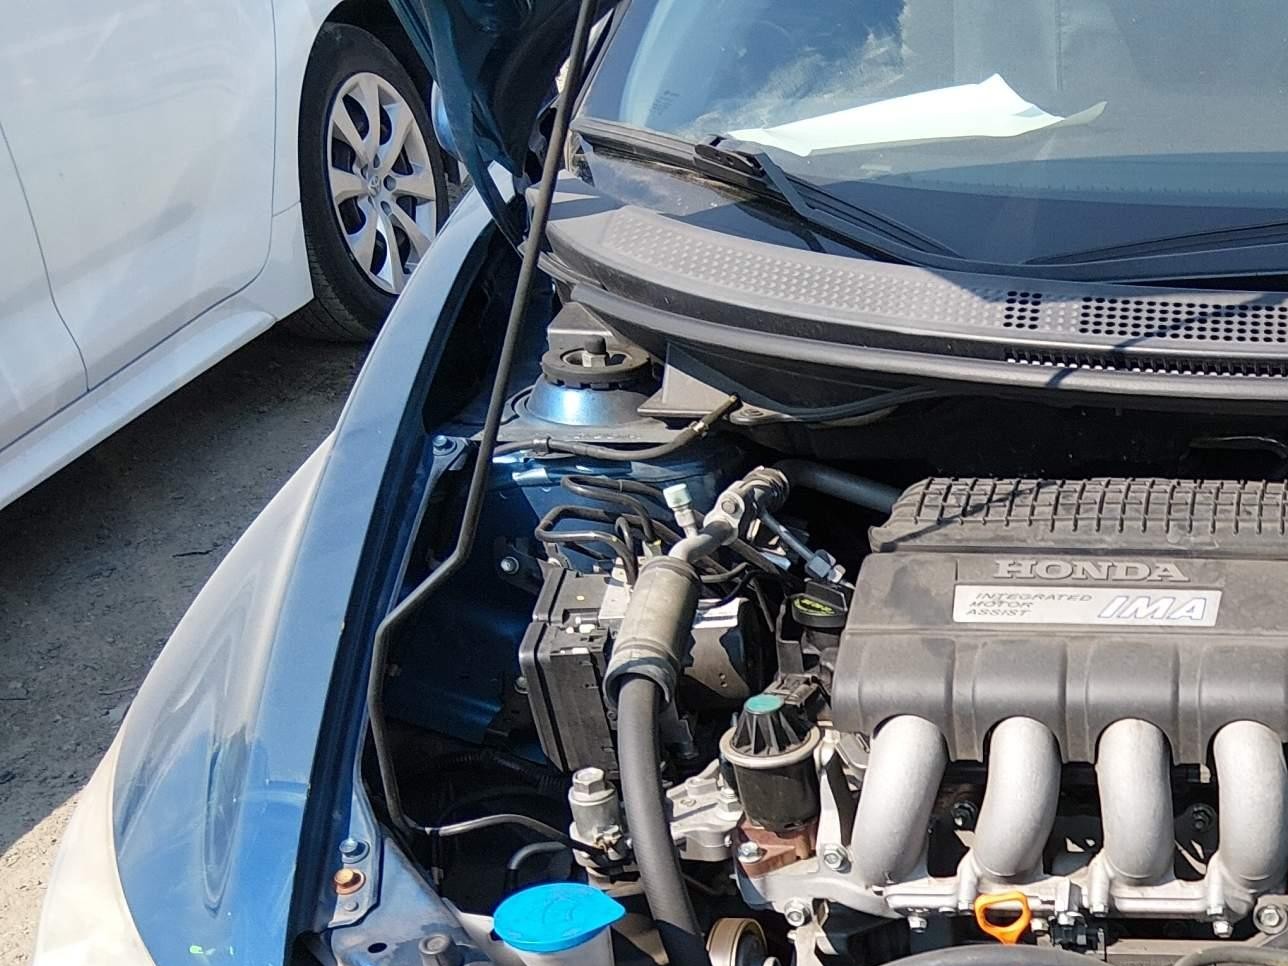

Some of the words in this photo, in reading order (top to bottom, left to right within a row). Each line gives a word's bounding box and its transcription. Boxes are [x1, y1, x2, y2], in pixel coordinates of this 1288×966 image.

[993, 559, 1191, 582] HONDA
[976, 592, 1093, 602] INTEGRATED
[968, 600, 1034, 609] MOTOR
[1098, 595, 1207, 621] IMA
[965, 608, 1032, 617] ASSIST
